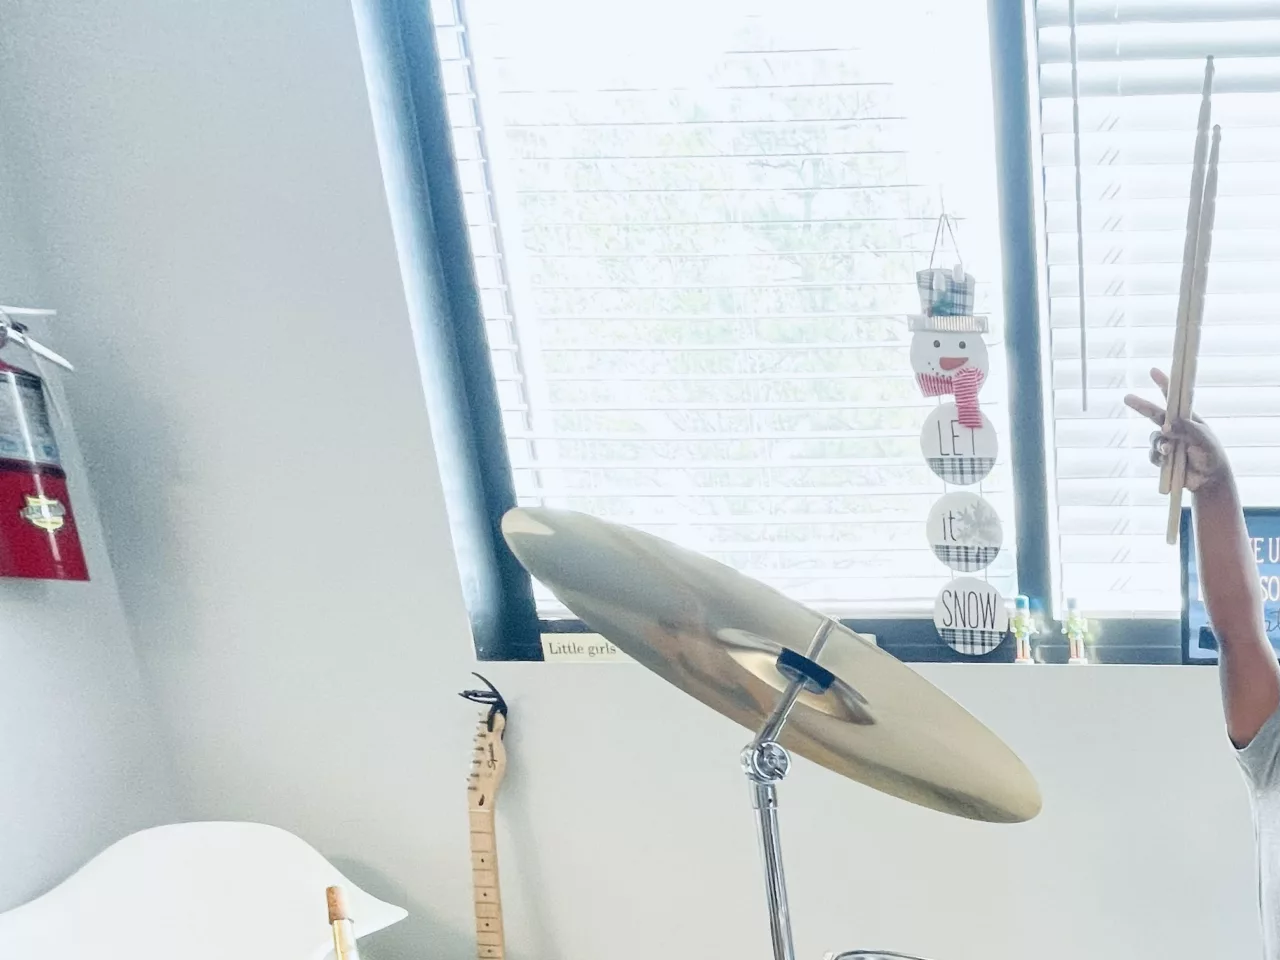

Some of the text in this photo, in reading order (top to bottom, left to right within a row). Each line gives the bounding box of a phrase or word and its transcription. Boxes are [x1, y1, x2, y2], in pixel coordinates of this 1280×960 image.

[942, 510, 957, 542] it
[941, 589, 997, 630] SNOW
[548, 642, 617, 657] Little girls
